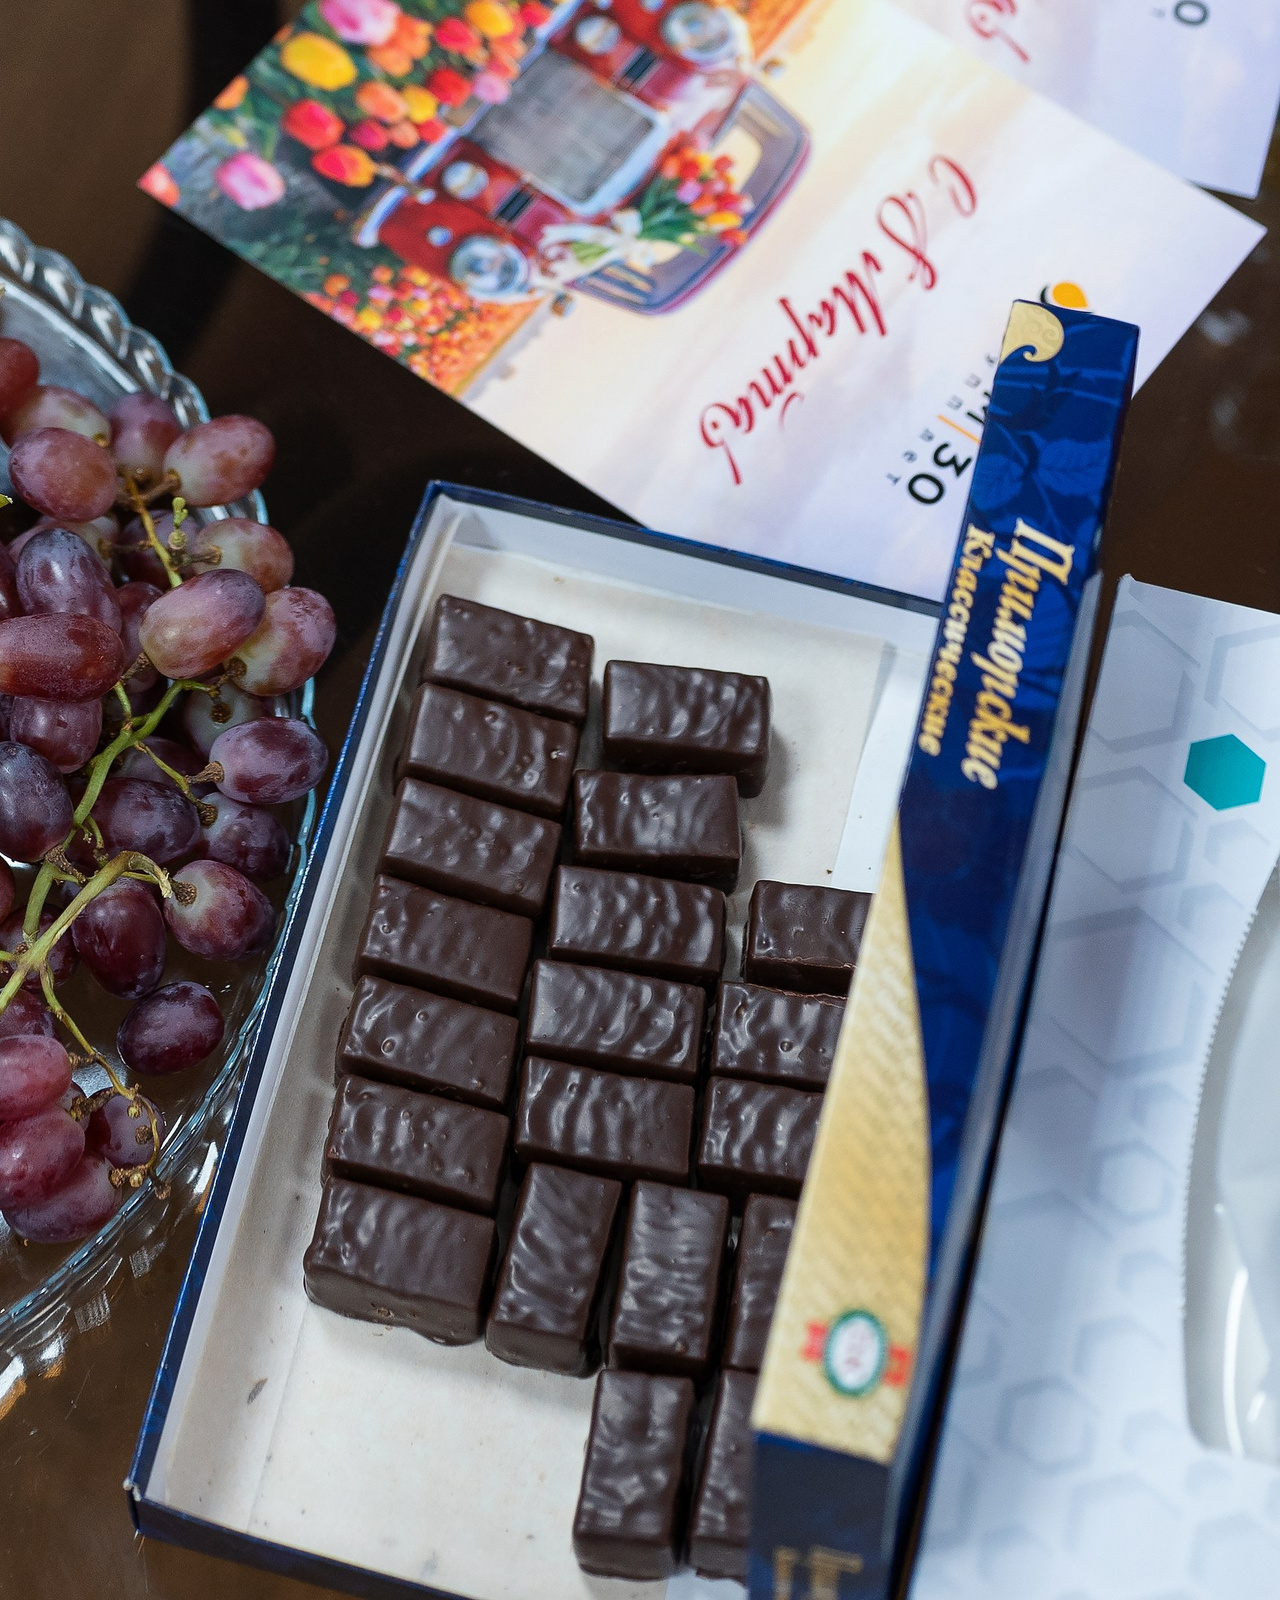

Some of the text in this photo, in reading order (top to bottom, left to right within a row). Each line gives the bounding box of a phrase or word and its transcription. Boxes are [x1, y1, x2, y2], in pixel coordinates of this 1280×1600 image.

[700, 154, 977, 486] С 8 Марта!
[907, 443, 972, 505] 30
[918, 522, 996, 757] Классические
[961, 517, 1075, 790] Приморские
